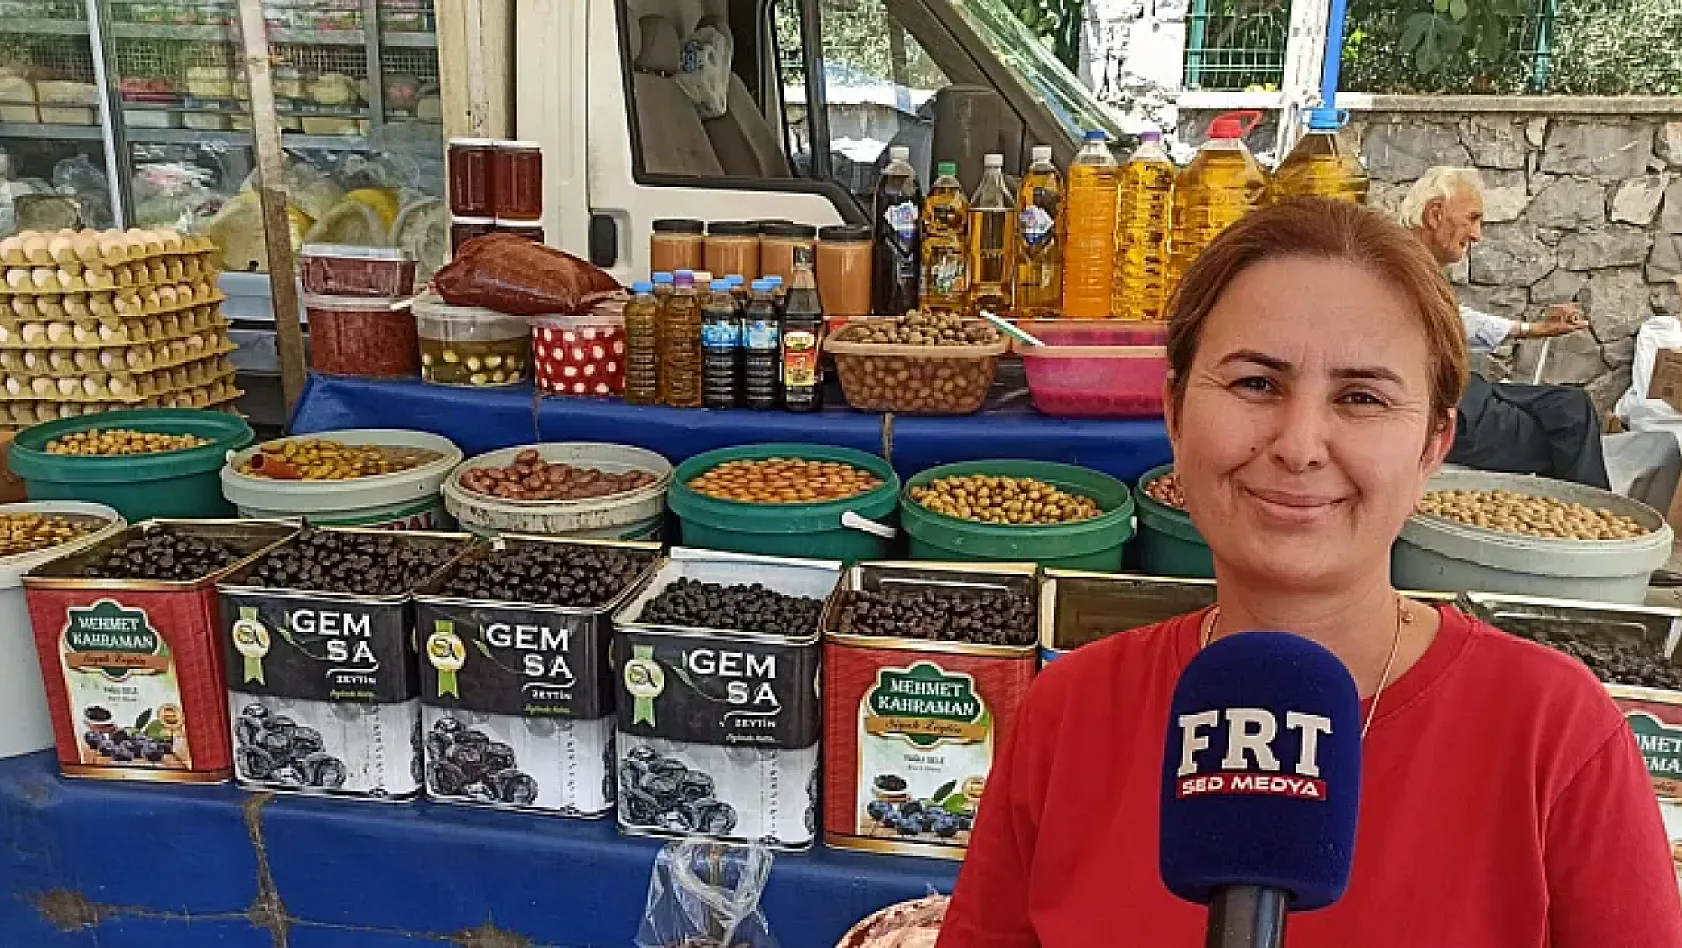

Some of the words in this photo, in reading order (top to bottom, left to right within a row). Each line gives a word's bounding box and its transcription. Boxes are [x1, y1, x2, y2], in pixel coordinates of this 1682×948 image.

[78, 616, 139, 631] MEHMET
[293, 610, 372, 638] GEM
[71, 631, 154, 649] KAHRAMAN
[487, 623, 569, 652] GEM
[326, 640, 376, 663] SA
[524, 653, 573, 679] SA
[689, 649, 776, 679] GEM
[727, 681, 779, 706] SA
[890, 678, 964, 697] MEHMET
[878, 696, 974, 716] KAHRAMAN
[1177, 708, 1333, 777] FRT
[1182, 777, 1224, 795] SED
[1231, 776, 1319, 796] MEDYA
